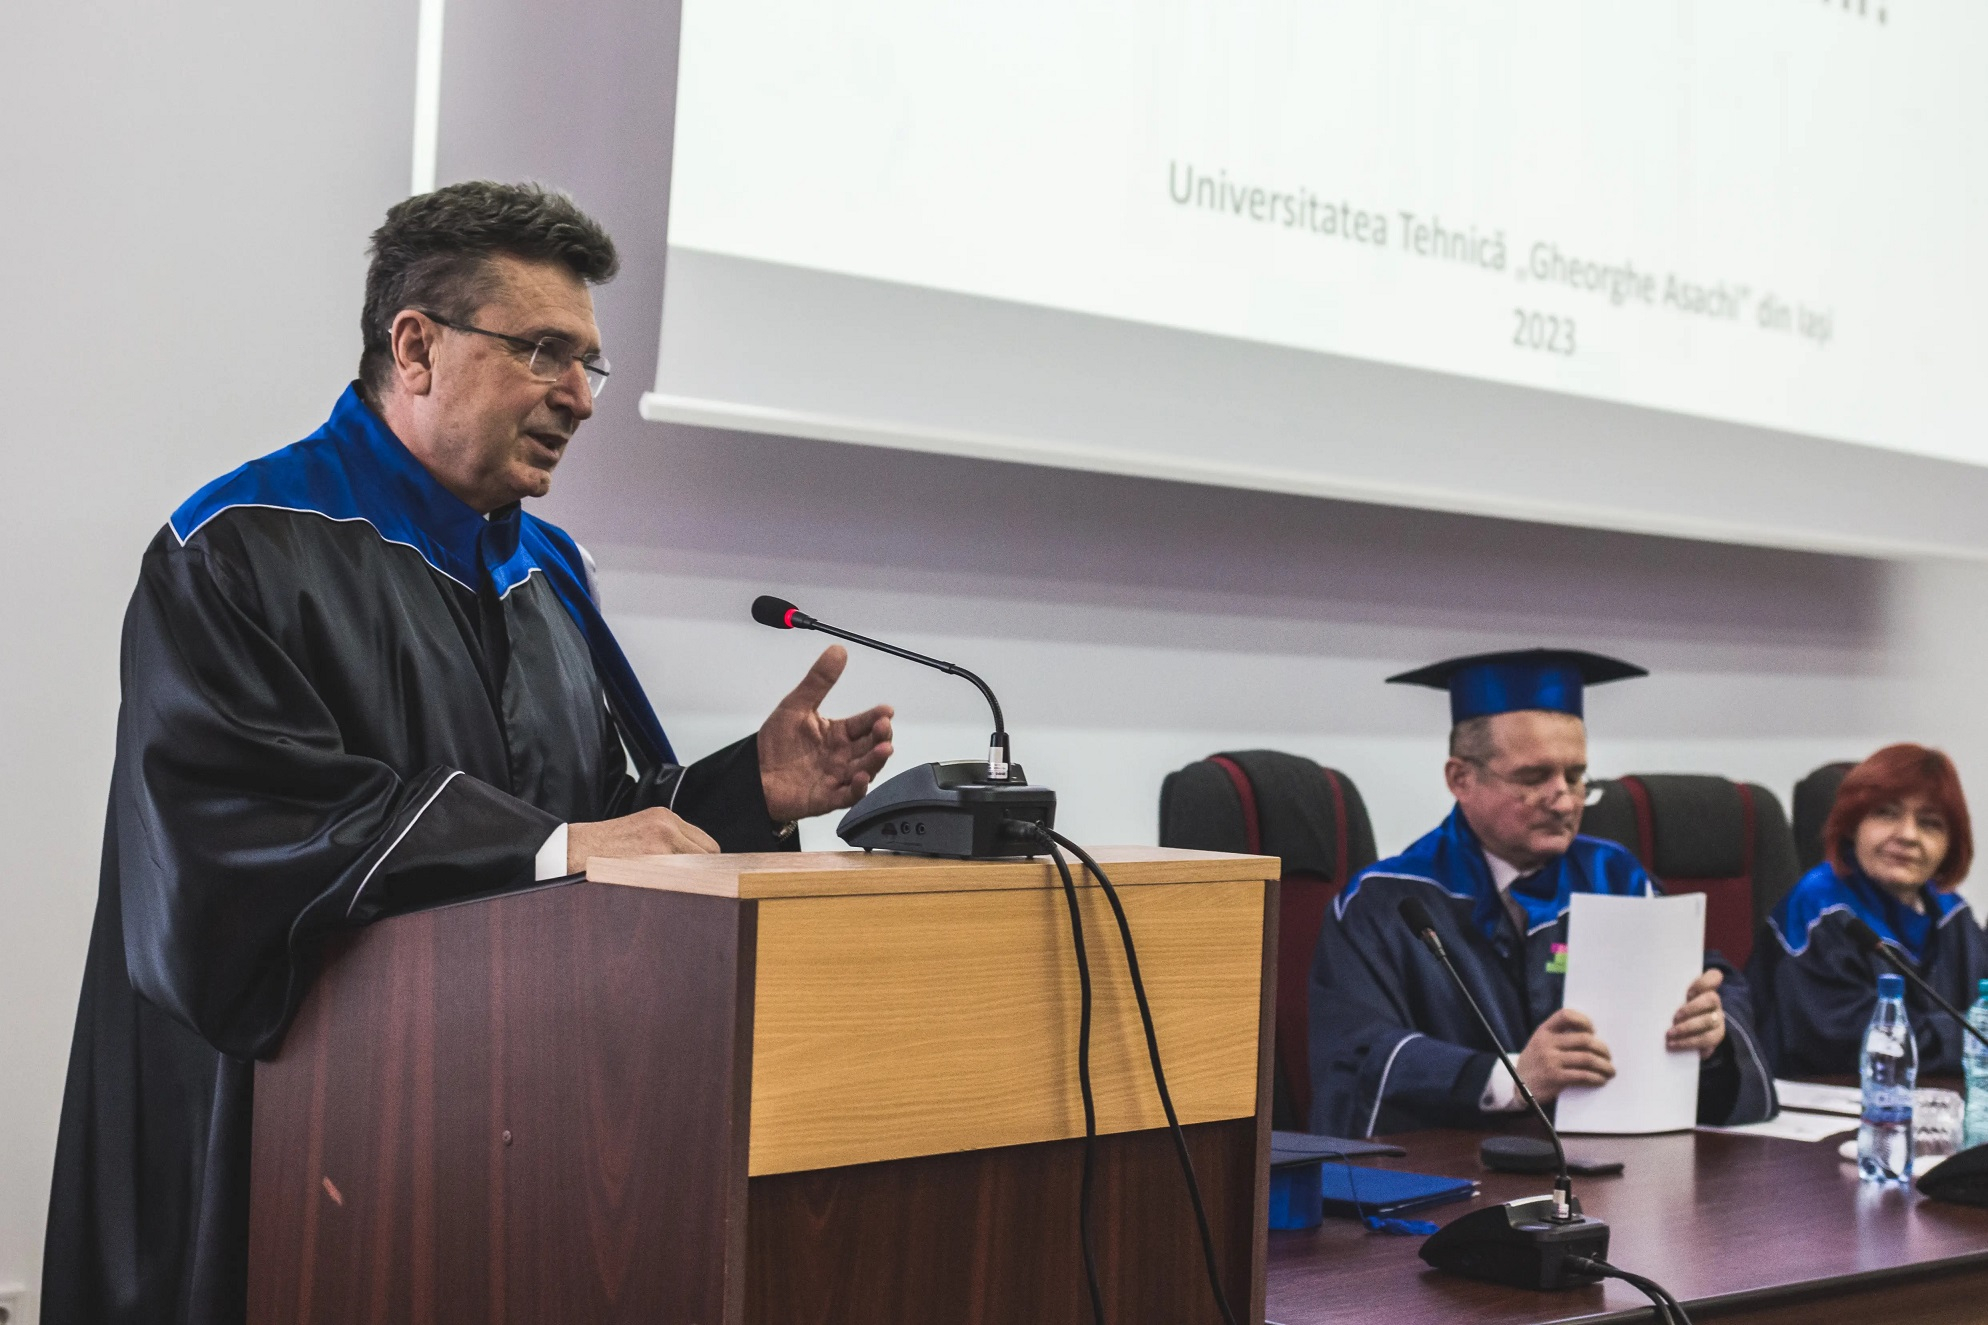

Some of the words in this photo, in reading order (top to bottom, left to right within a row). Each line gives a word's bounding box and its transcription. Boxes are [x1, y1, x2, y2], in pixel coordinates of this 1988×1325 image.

[1168, 158, 1388, 247] Universitatea
[1398, 208, 1507, 272] Tehnică
[1757, 290, 1793, 332] din
[1512, 306, 1577, 357] 2023
